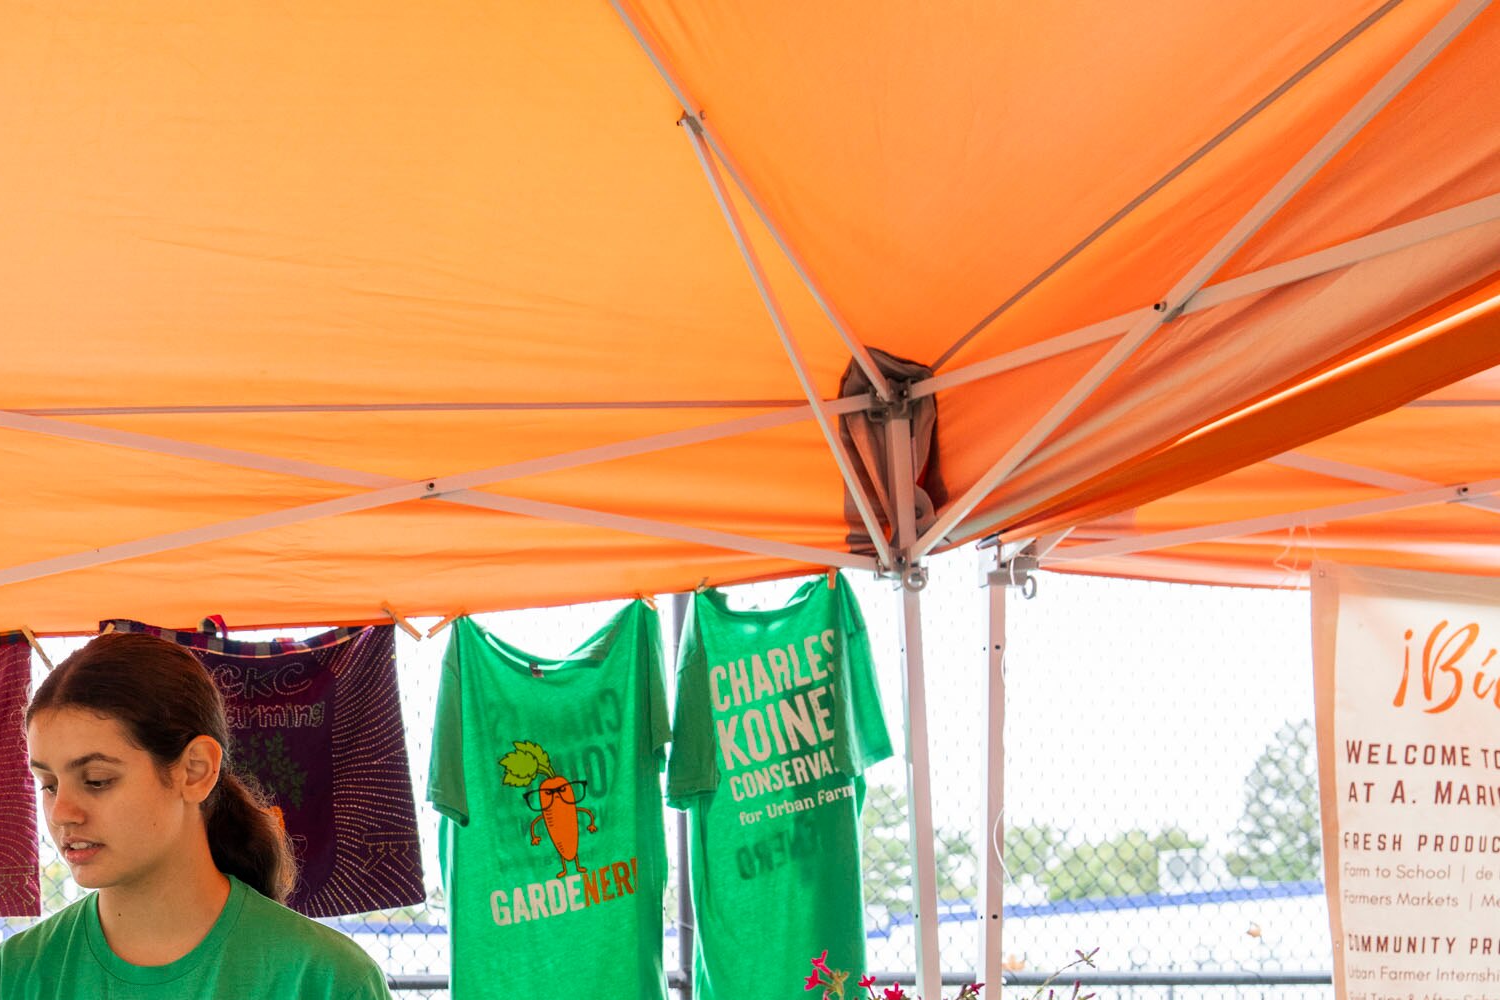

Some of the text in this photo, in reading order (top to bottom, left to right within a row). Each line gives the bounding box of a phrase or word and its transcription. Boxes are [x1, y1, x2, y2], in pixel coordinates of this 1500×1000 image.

[1346, 739, 1472, 767] WELCOME
[1348, 780, 1500, 807] AT A. MARI
[739, 808, 763, 826] for
[765, 796, 816, 820] Urban
[1344, 832, 1403, 852] FRESH
[1344, 861, 1494, 881] Farm to School de
[1344, 889, 1393, 906] Farmers
[1396, 891, 1459, 908] Markets
[1469, 937, 1500, 955] PR
[1380, 966, 1431, 982] Farmer
